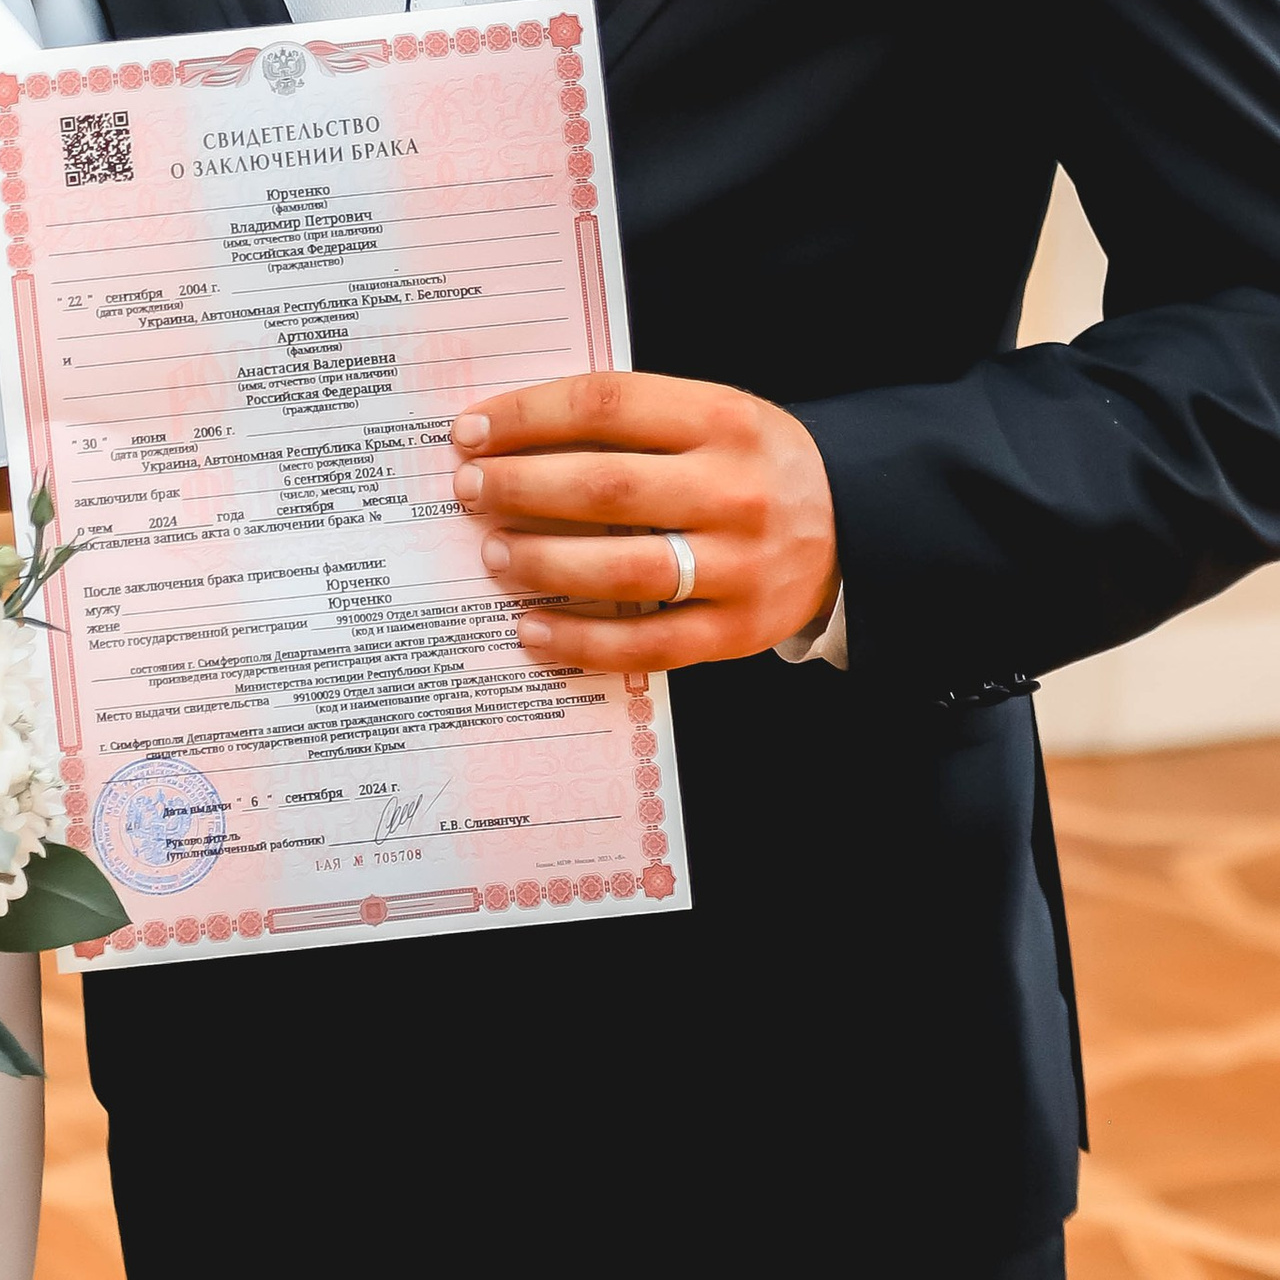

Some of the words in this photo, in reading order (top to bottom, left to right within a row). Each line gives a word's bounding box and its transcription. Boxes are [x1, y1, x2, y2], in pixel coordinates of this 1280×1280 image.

[203, 116, 379, 149] СВИДЕТЕЛЬСТВО
[170, 162, 184, 178] О
[193, 146, 342, 176] ЗАКЛЮЧЕНИИ
[351, 138, 418, 160] БРАКА
[266, 186, 332, 204] Юрченко
[271, 199, 327, 215] (фамилия)
[230, 218, 300, 234] Владимир
[304, 211, 372, 227] Петрович
[253, 234, 301, 245] отчество
[303, 230, 328, 241] (при
[330, 224, 383, 237] наличии)
[231, 247, 304, 262] Российская
[307, 240, 377, 256] Федерация
[267, 256, 344, 272] (гражданство)
[67, 295, 82, 307] 22
[105, 288, 163, 303] сентября
[178, 283, 207, 296] 2004
[211, 284, 220, 292] г.
[348, 274, 446, 292] (национальность)
[95, 308, 123, 319] (дата
[125, 300, 183, 317] рождения)
[138, 315, 199, 329] Украина,
[201, 305, 280, 321] Автономная
[283, 298, 360, 316] Республика
[361, 294, 402, 307] Крым,
[404, 293, 413, 301] г.
[417, 286, 482, 300] Белогорск
[264, 318, 298, 328] (место
[301, 310, 359, 326] рождения)
[277, 327, 349, 346] Артюхина
[62, 357, 71, 365] и
[286, 342, 342, 357] (фамилия)
[237, 362, 309, 378] Анастасия
[312, 353, 396, 370] Валериевна
[268, 377, 316, 388] отчество
[318, 374, 343, 384] (при
[345, 367, 397, 380] наличии)
[246, 390, 319, 405] Российская
[322, 383, 393, 400] Федерация
[282, 399, 358, 416] (гражданство)
[82, 438, 97, 450] 30
[131, 433, 166, 444] июня
[193, 425, 222, 438] 2006
[226, 426, 235, 435] г.
[110, 451, 138, 461] (дата
[140, 443, 198, 460] рождения)
[141, 459, 201, 473] Украина,
[204, 450, 283, 466] Автономная
[286, 442, 361, 457] Республика
[364, 438, 405, 451] Крым,
[278, 461, 313, 472] (место
[316, 454, 374, 470] рождения)
[74, 492, 147, 507] заключили
[150, 488, 180, 502] брак
[283, 475, 291, 486] 6
[294, 470, 352, 485] сентября
[354, 466, 383, 479] 2024
[279, 489, 318, 501] (число,
[320, 485, 356, 496] месяц,
[358, 481, 379, 492] год)
[87, 524, 112, 534] чем
[148, 516, 177, 529] 2024
[216, 511, 245, 522] года
[276, 500, 335, 516] сентября
[362, 494, 408, 506] месяца
[153, 531, 198, 544] запись
[201, 528, 230, 539] акта
[232, 526, 241, 536] о
[244, 518, 324, 535] заключении
[327, 514, 365, 528] брака
[369, 510, 382, 522] №
[83, 586, 121, 598] После
[124, 577, 204, 594] заключения
[207, 573, 244, 587] брака
[247, 566, 319, 583] присвоены
[322, 559, 386, 576] фамилии:
[85, 604, 120, 618] мужу
[326, 575, 390, 591] Юрченко
[86, 622, 120, 634] жене
[328, 594, 392, 609] Юрченко
[88, 639, 125, 650] Место
[127, 626, 229, 646] государственной
[231, 620, 307, 638] регистрации
[336, 611, 383, 625] 99100029
[386, 610, 419, 620] Отдел
[420, 605, 458, 616] записи
[461, 602, 491, 612] актов
[351, 627, 375, 637] (код
[386, 618, 466, 632] наименование
[130, 662, 185, 674] состояния
[197, 653, 273, 667] Симферополя
[274, 645, 351, 661] Департамента
[354, 641, 392, 652] записи
[394, 638, 425, 647] актов
[427, 630, 503, 646] гражданского
[148, 672, 218, 687] произведена
[220, 662, 311, 679] государственная
[313, 655, 382, 671] регистрация
[384, 652, 408, 661] акта
[410, 645, 485, 661] гражданского
[234, 678, 312, 693] Министерства
[315, 673, 364, 685] юстиции
[366, 666, 432, 682] Республики
[433, 662, 465, 675] Крым
[96, 712, 132, 722] Место
[135, 706, 180, 718] выдачи
[183, 697, 269, 713] свидетельства
[293, 689, 340, 702] 99100029
[343, 687, 375, 698] Отдел
[377, 683, 415, 693] записи
[418, 679, 448, 689] актов
[450, 672, 526, 688] гражданского
[315, 704, 339, 714] (код
[350, 694, 430, 710] наименование
[433, 690, 472, 703] органа,
[474, 685, 522, 697] которым
[525, 681, 566, 692] выдано
[110, 736, 184, 750] Симферополя
[186, 728, 264, 744] Департамента
[266, 723, 304, 734] записи
[307, 720, 338, 730] актов
[340, 712, 416, 728] гражданского
[417, 706, 472, 718] состояния
[474, 698, 553, 712] Министерства
[555, 693, 605, 705] юстиции
[144, 745, 224, 761] свидетельство
[236, 733, 328, 751] государственной
[329, 726, 399, 743] регистрации
[402, 724, 425, 733] акта
[428, 716, 503, 732] гражданского
[506, 709, 565, 722] состояния)
[308, 745, 371, 759] Республики
[374, 742, 405, 753] Крым
[162, 807, 188, 818] Дата
[189, 802, 231, 814] выдачи
[251, 796, 258, 807] 6
[285, 788, 343, 803] сентября
[358, 782, 387, 795] 2024
[165, 832, 240, 849] Руководитель
[166, 841, 267, 862] (уполномоченный
[269, 835, 325, 852] работник)
[464, 815, 530, 831] Сливянчук
[373, 848, 421, 864] 705708
